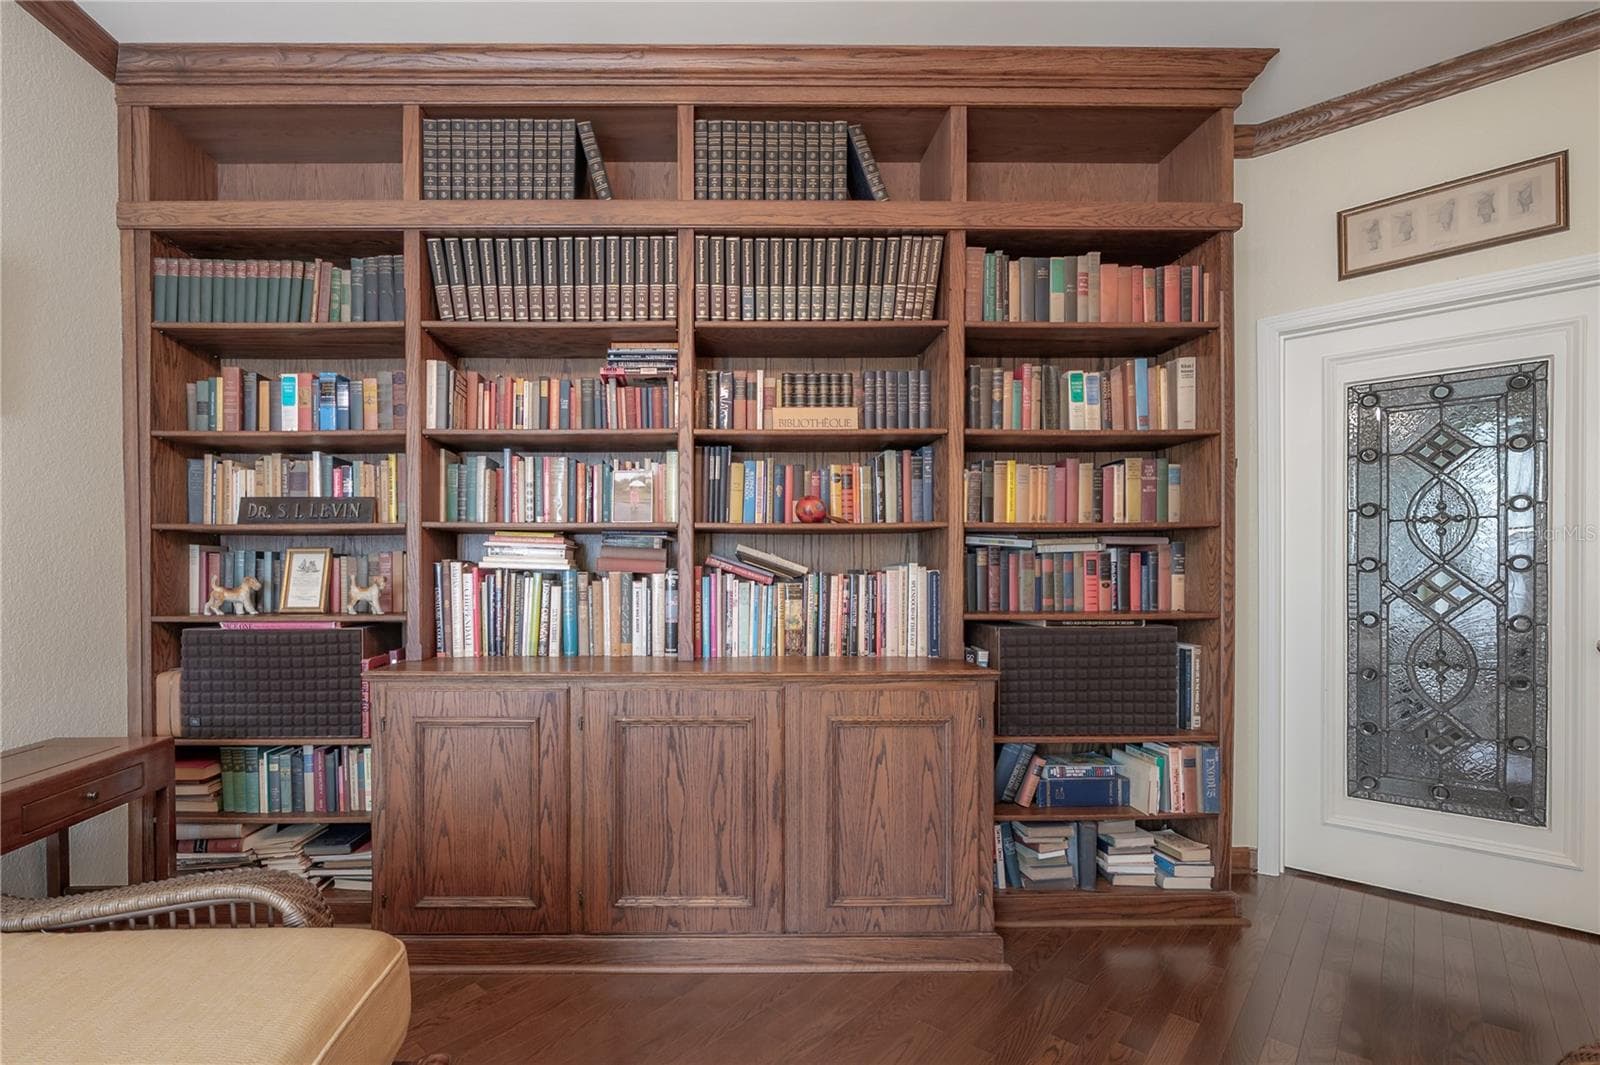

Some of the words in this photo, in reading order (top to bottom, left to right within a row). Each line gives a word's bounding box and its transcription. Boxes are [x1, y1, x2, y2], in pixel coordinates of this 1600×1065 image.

[248, 502, 271, 518] DR.
[278, 503, 290, 519] S.
[294, 503, 303, 518] I.
[309, 502, 361, 518] LEVIN
[1207, 758, 1216, 798] EXODUS
